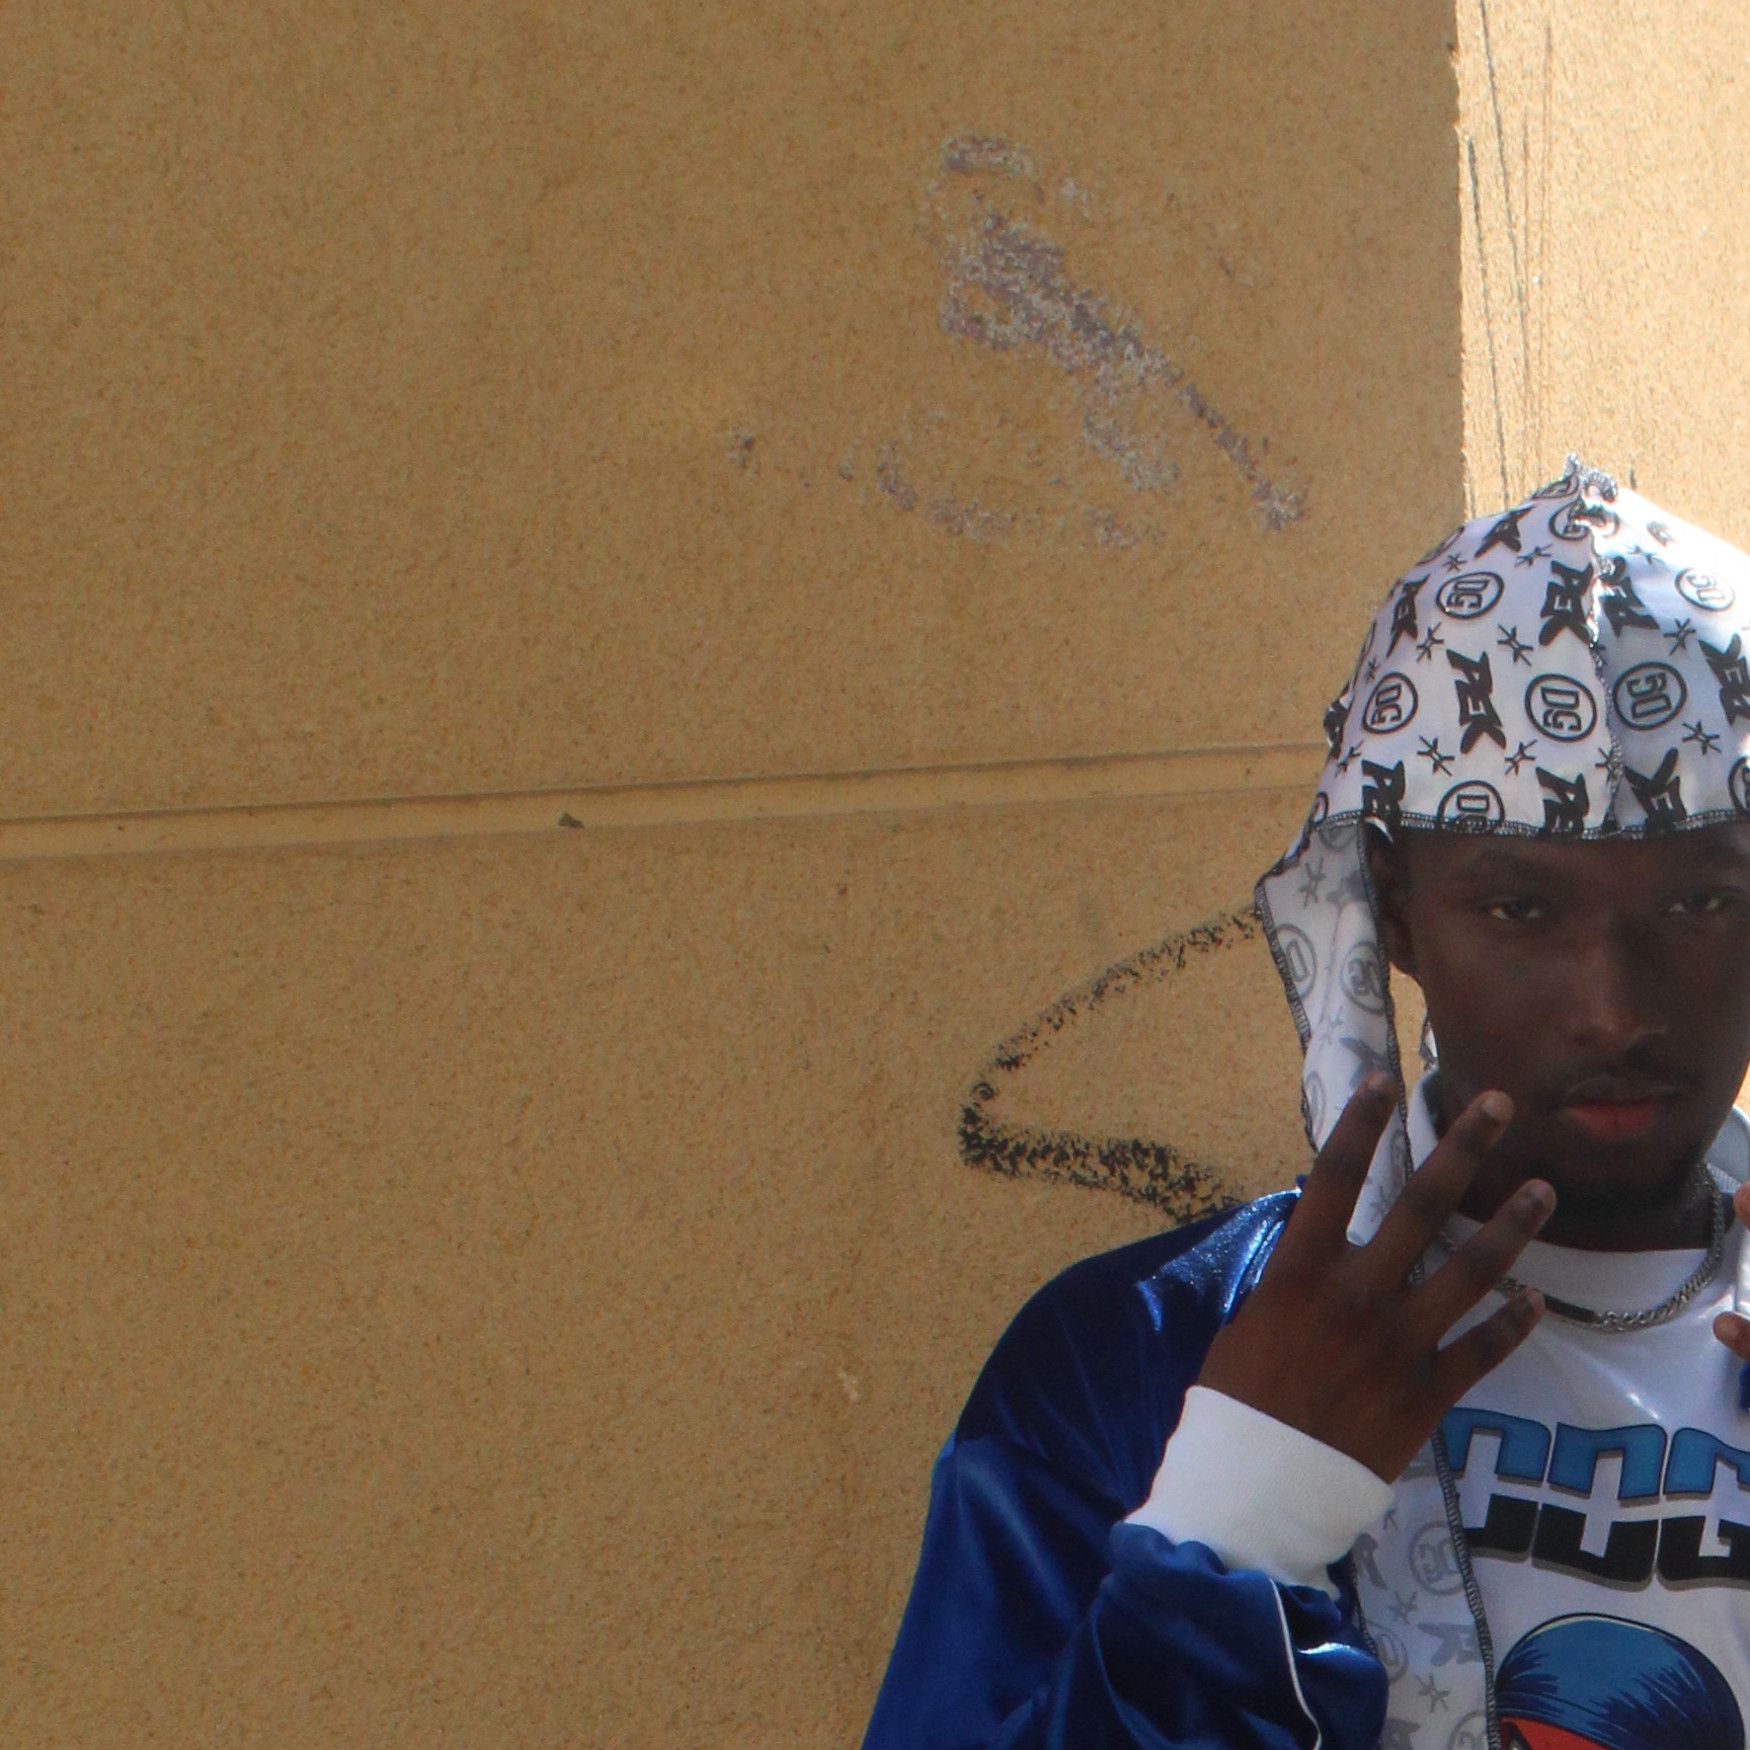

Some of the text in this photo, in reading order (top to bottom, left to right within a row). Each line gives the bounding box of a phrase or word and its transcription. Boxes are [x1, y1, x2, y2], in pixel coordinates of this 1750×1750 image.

[1369, 683, 1404, 727] DG
[1539, 685, 1583, 732] DG
[1626, 671, 1673, 719] DG
